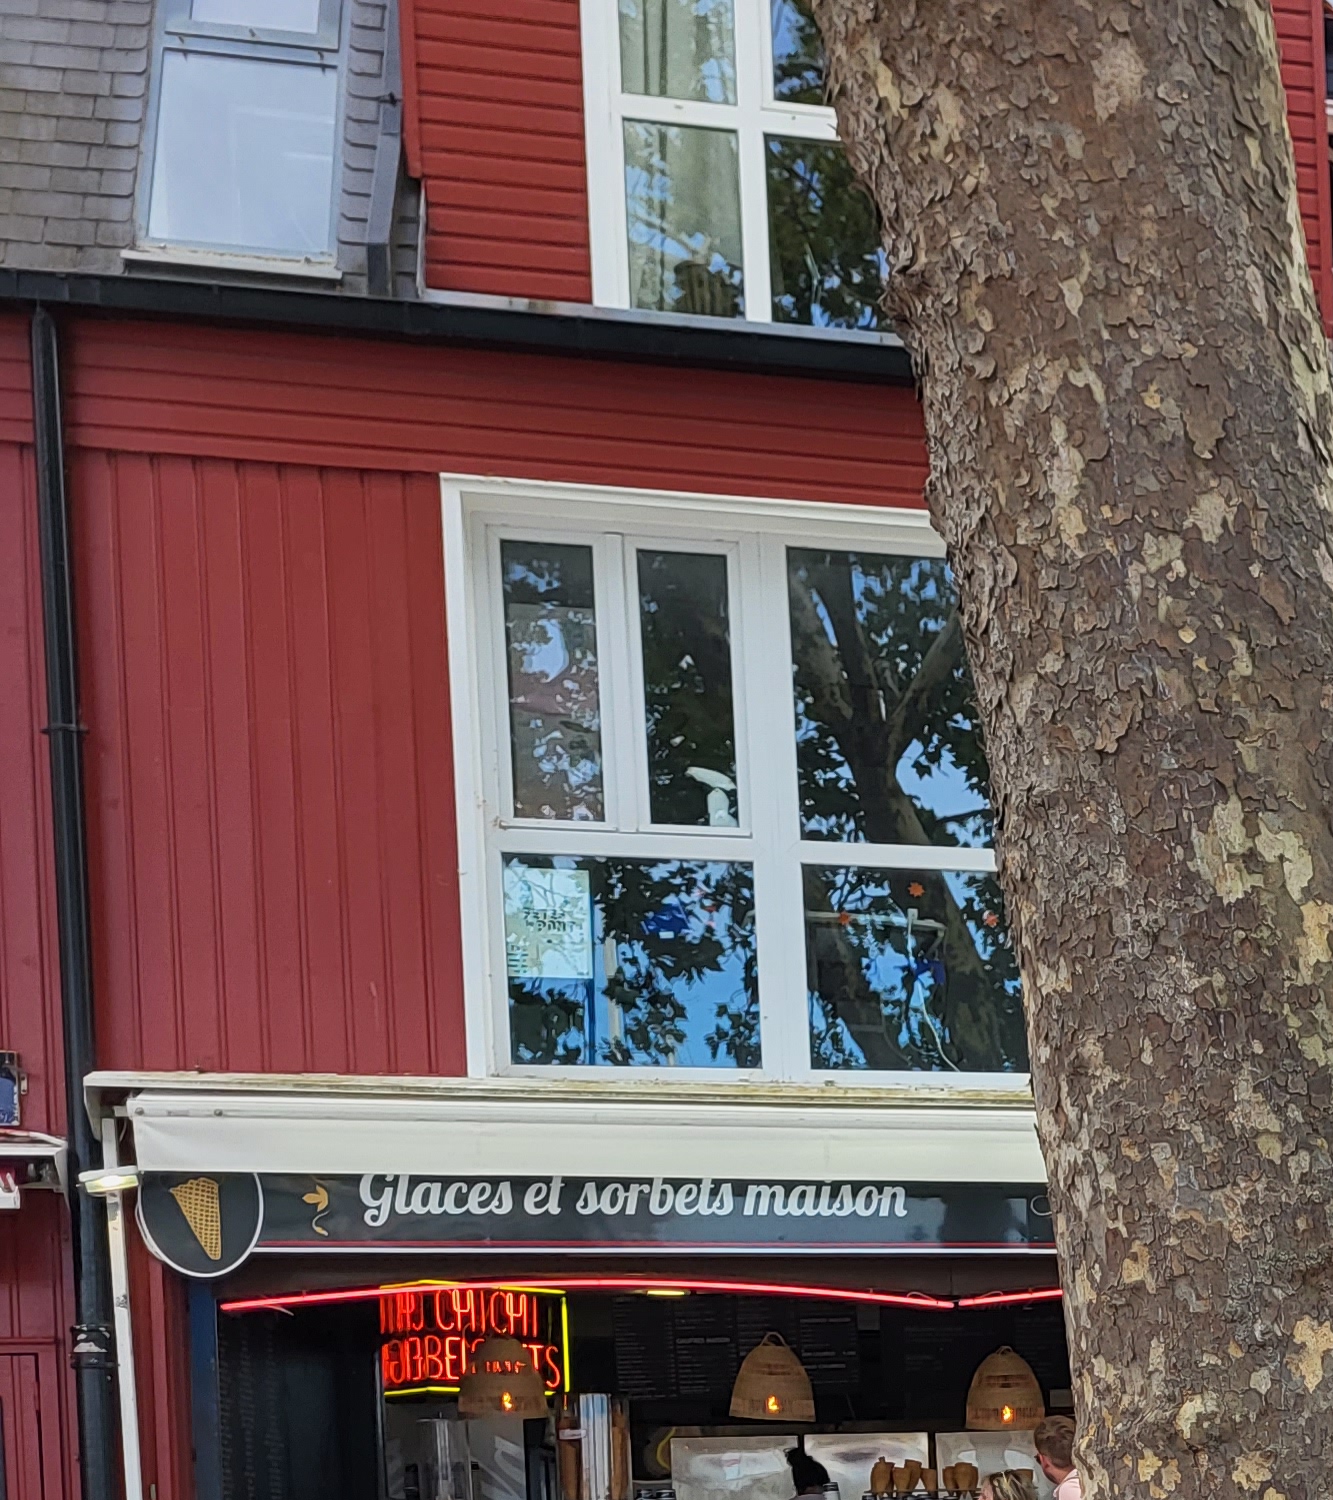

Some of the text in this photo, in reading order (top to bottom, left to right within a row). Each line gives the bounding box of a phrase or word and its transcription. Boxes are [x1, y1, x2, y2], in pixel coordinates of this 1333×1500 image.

[359, 1174, 908, 1226] Glaces et sorbets maison
